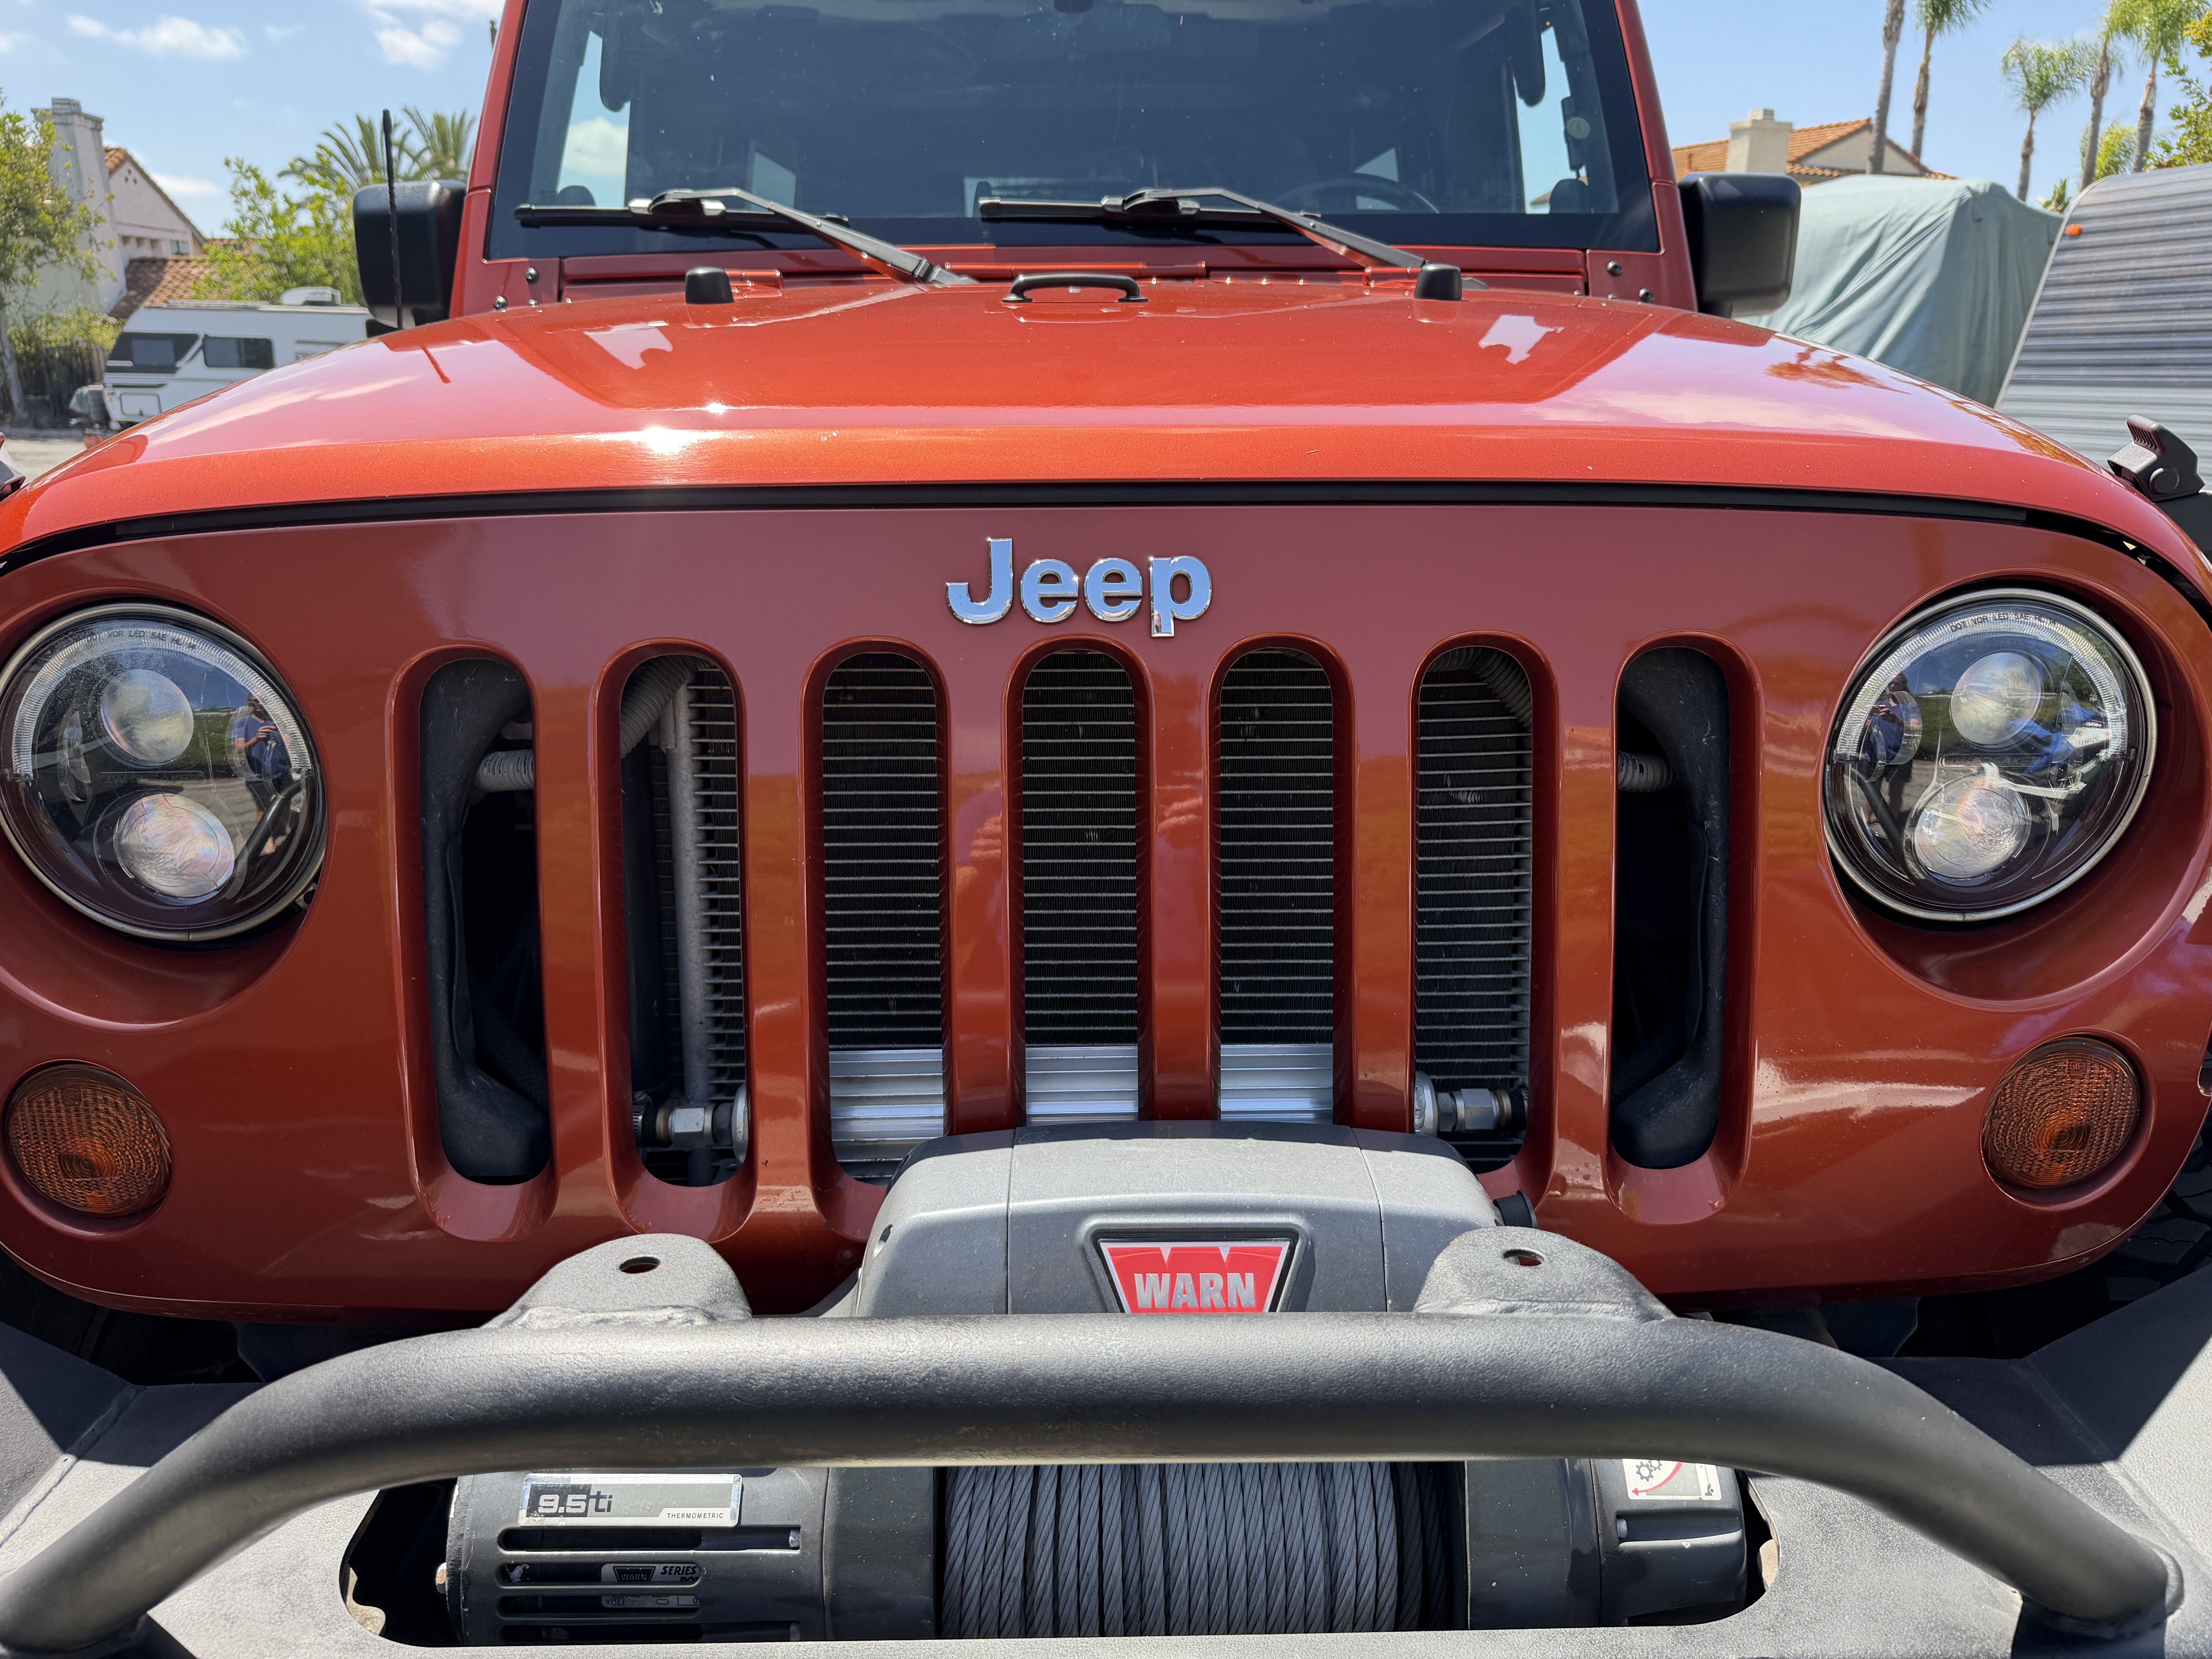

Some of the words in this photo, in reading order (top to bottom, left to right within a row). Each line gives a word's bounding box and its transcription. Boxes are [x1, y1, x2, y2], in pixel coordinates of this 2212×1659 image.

[946, 538, 1212, 637] Jeep
[1950, 620, 1968, 632] DOT
[1971, 615, 1988, 625] VOR
[151, 632, 168, 641] SAE
[1134, 1272, 1255, 1308] WARN
[661, 1566, 697, 1575] SERIES
